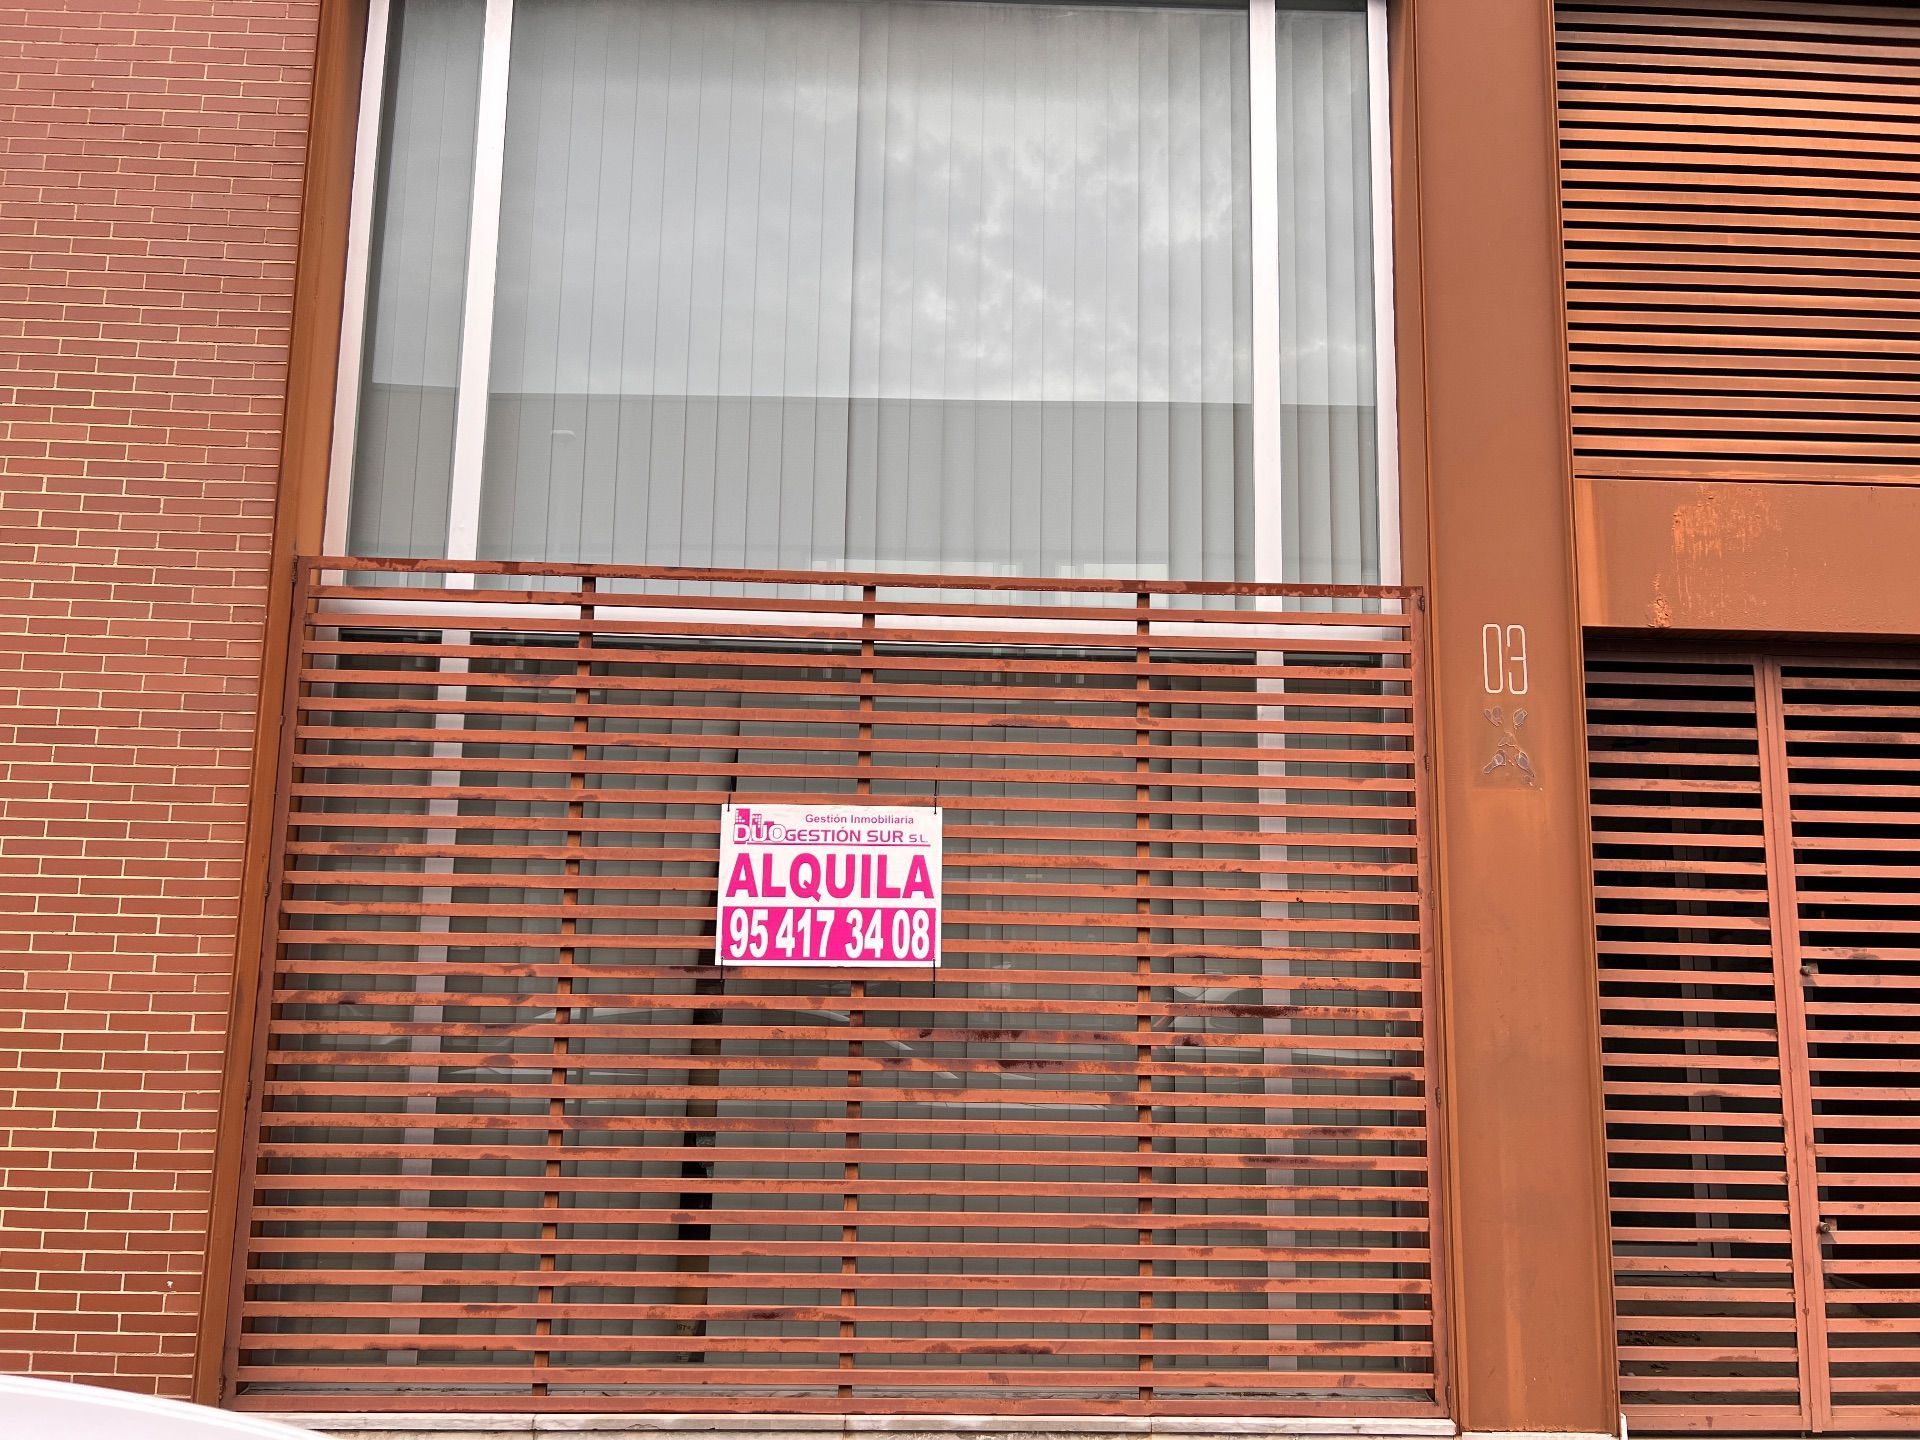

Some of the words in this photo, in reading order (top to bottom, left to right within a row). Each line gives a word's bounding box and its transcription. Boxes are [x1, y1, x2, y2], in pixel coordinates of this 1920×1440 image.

[1483, 623, 1528, 695] 03
[805, 813, 847, 824] Gestión
[850, 814, 914, 824] Inmobiliaria
[867, 829, 904, 843] SUR
[725, 852, 935, 902] ALQUILA
[729, 908, 769, 958] 95
[775, 908, 836, 958] 417
[845, 909, 884, 959] 34
[891, 909, 930, 960] 08
